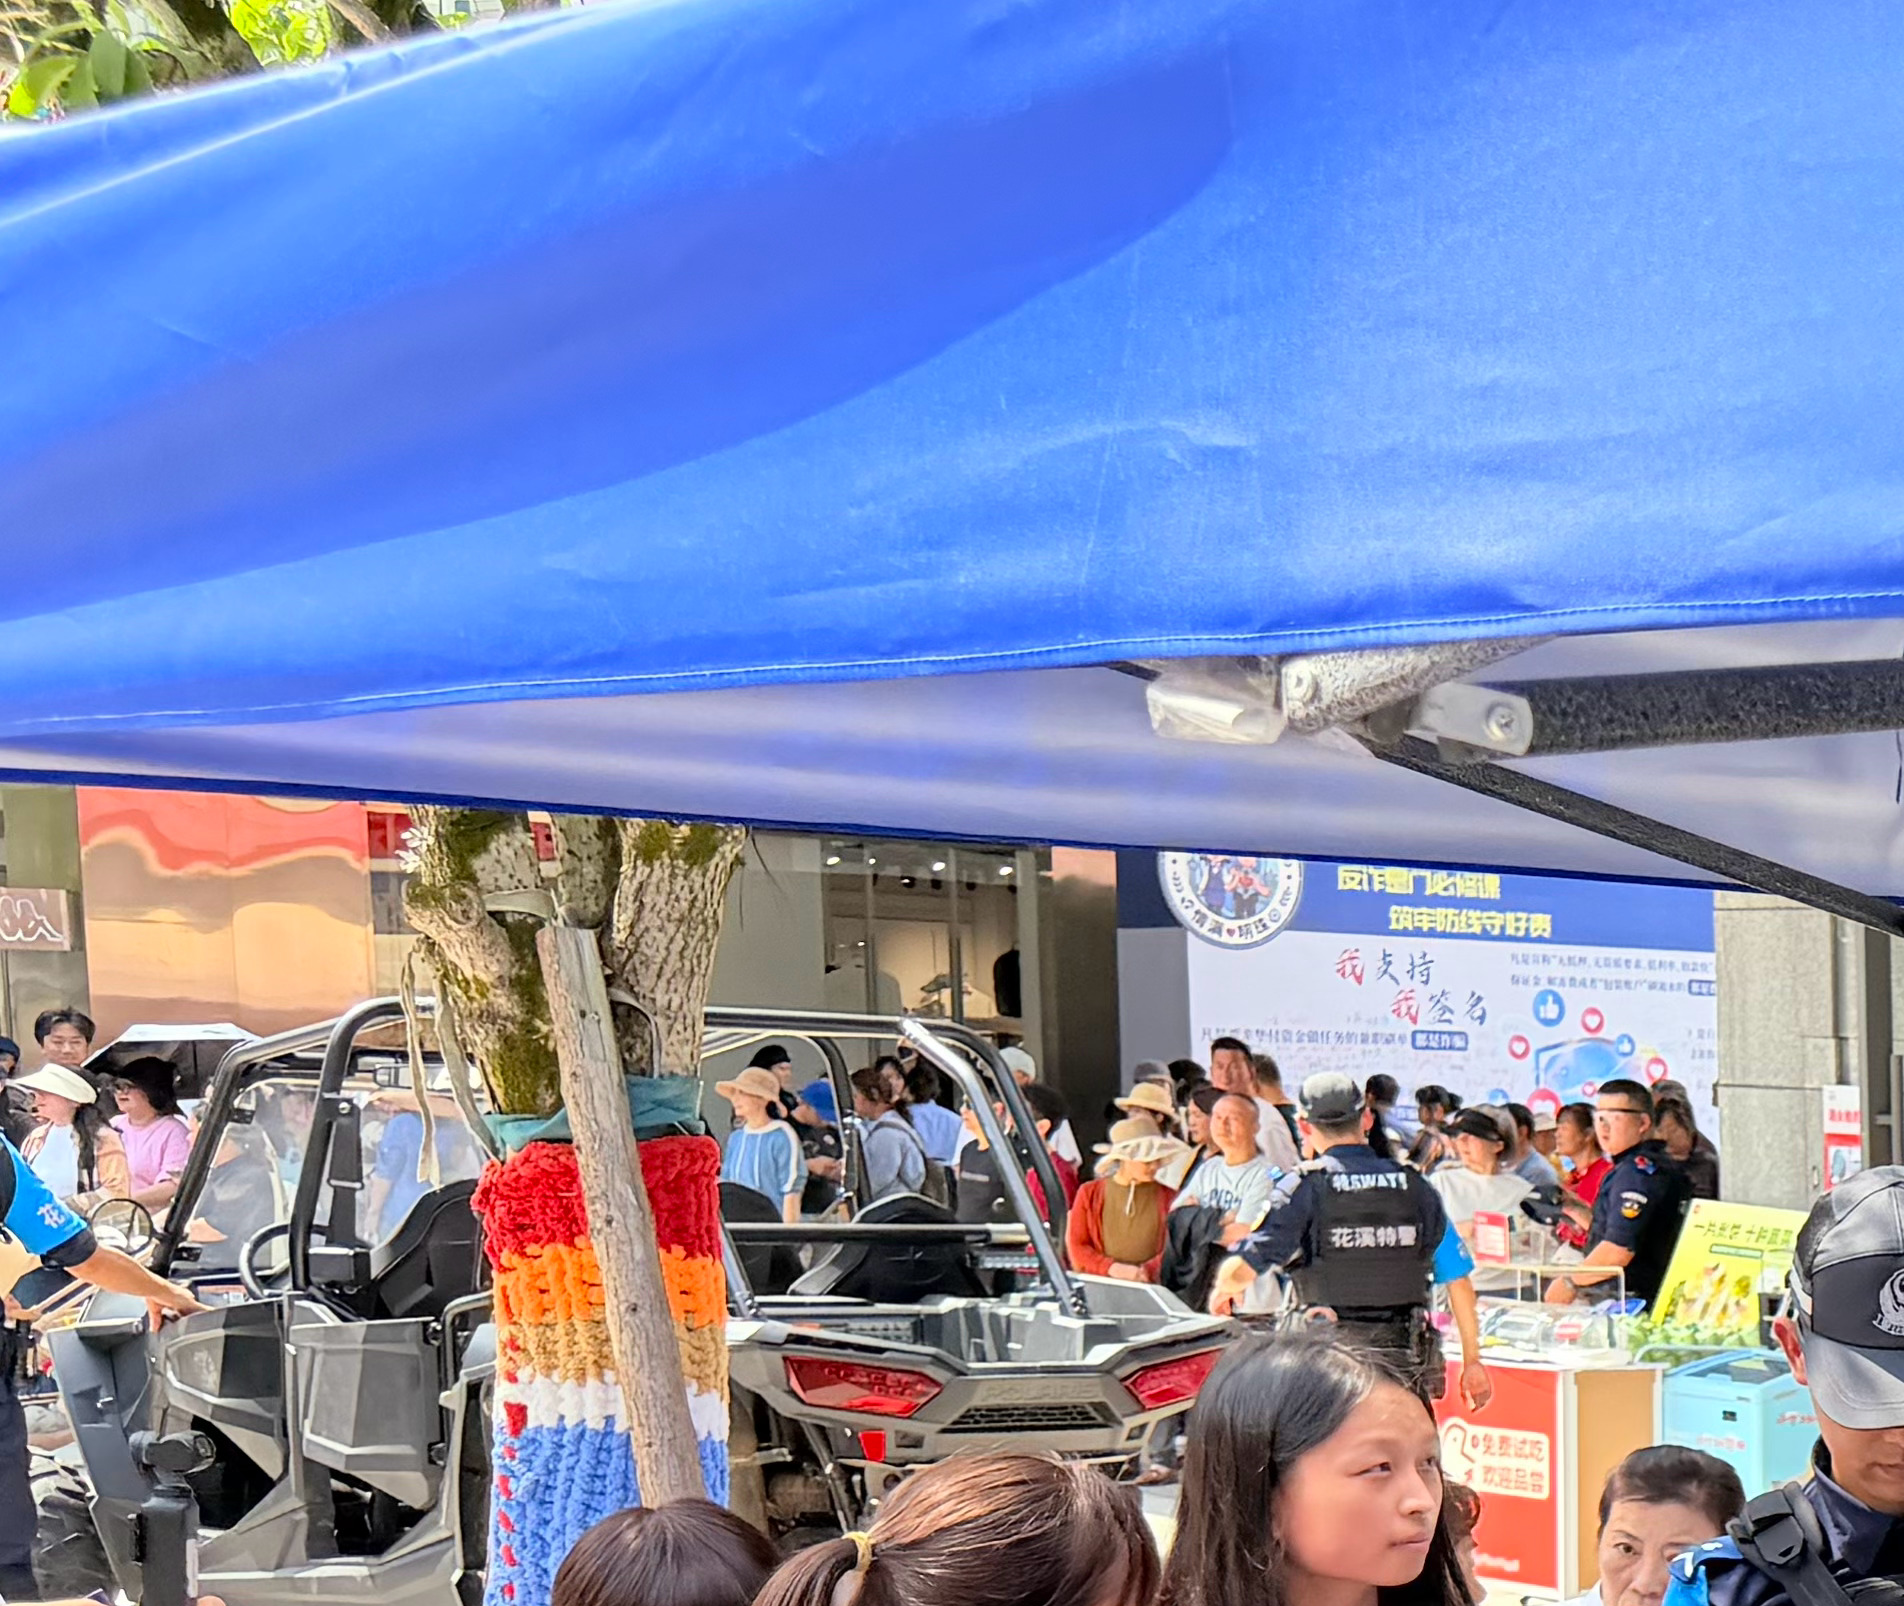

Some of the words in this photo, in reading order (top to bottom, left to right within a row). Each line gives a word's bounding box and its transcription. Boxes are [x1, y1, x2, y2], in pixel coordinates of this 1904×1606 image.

[1335, 947, 1434, 986] 我支持
[1390, 988, 1488, 1026] 我签名
[1330, 1225, 1418, 1248] 花溪特警
[1483, 1432, 1546, 1462] 免费试吃
